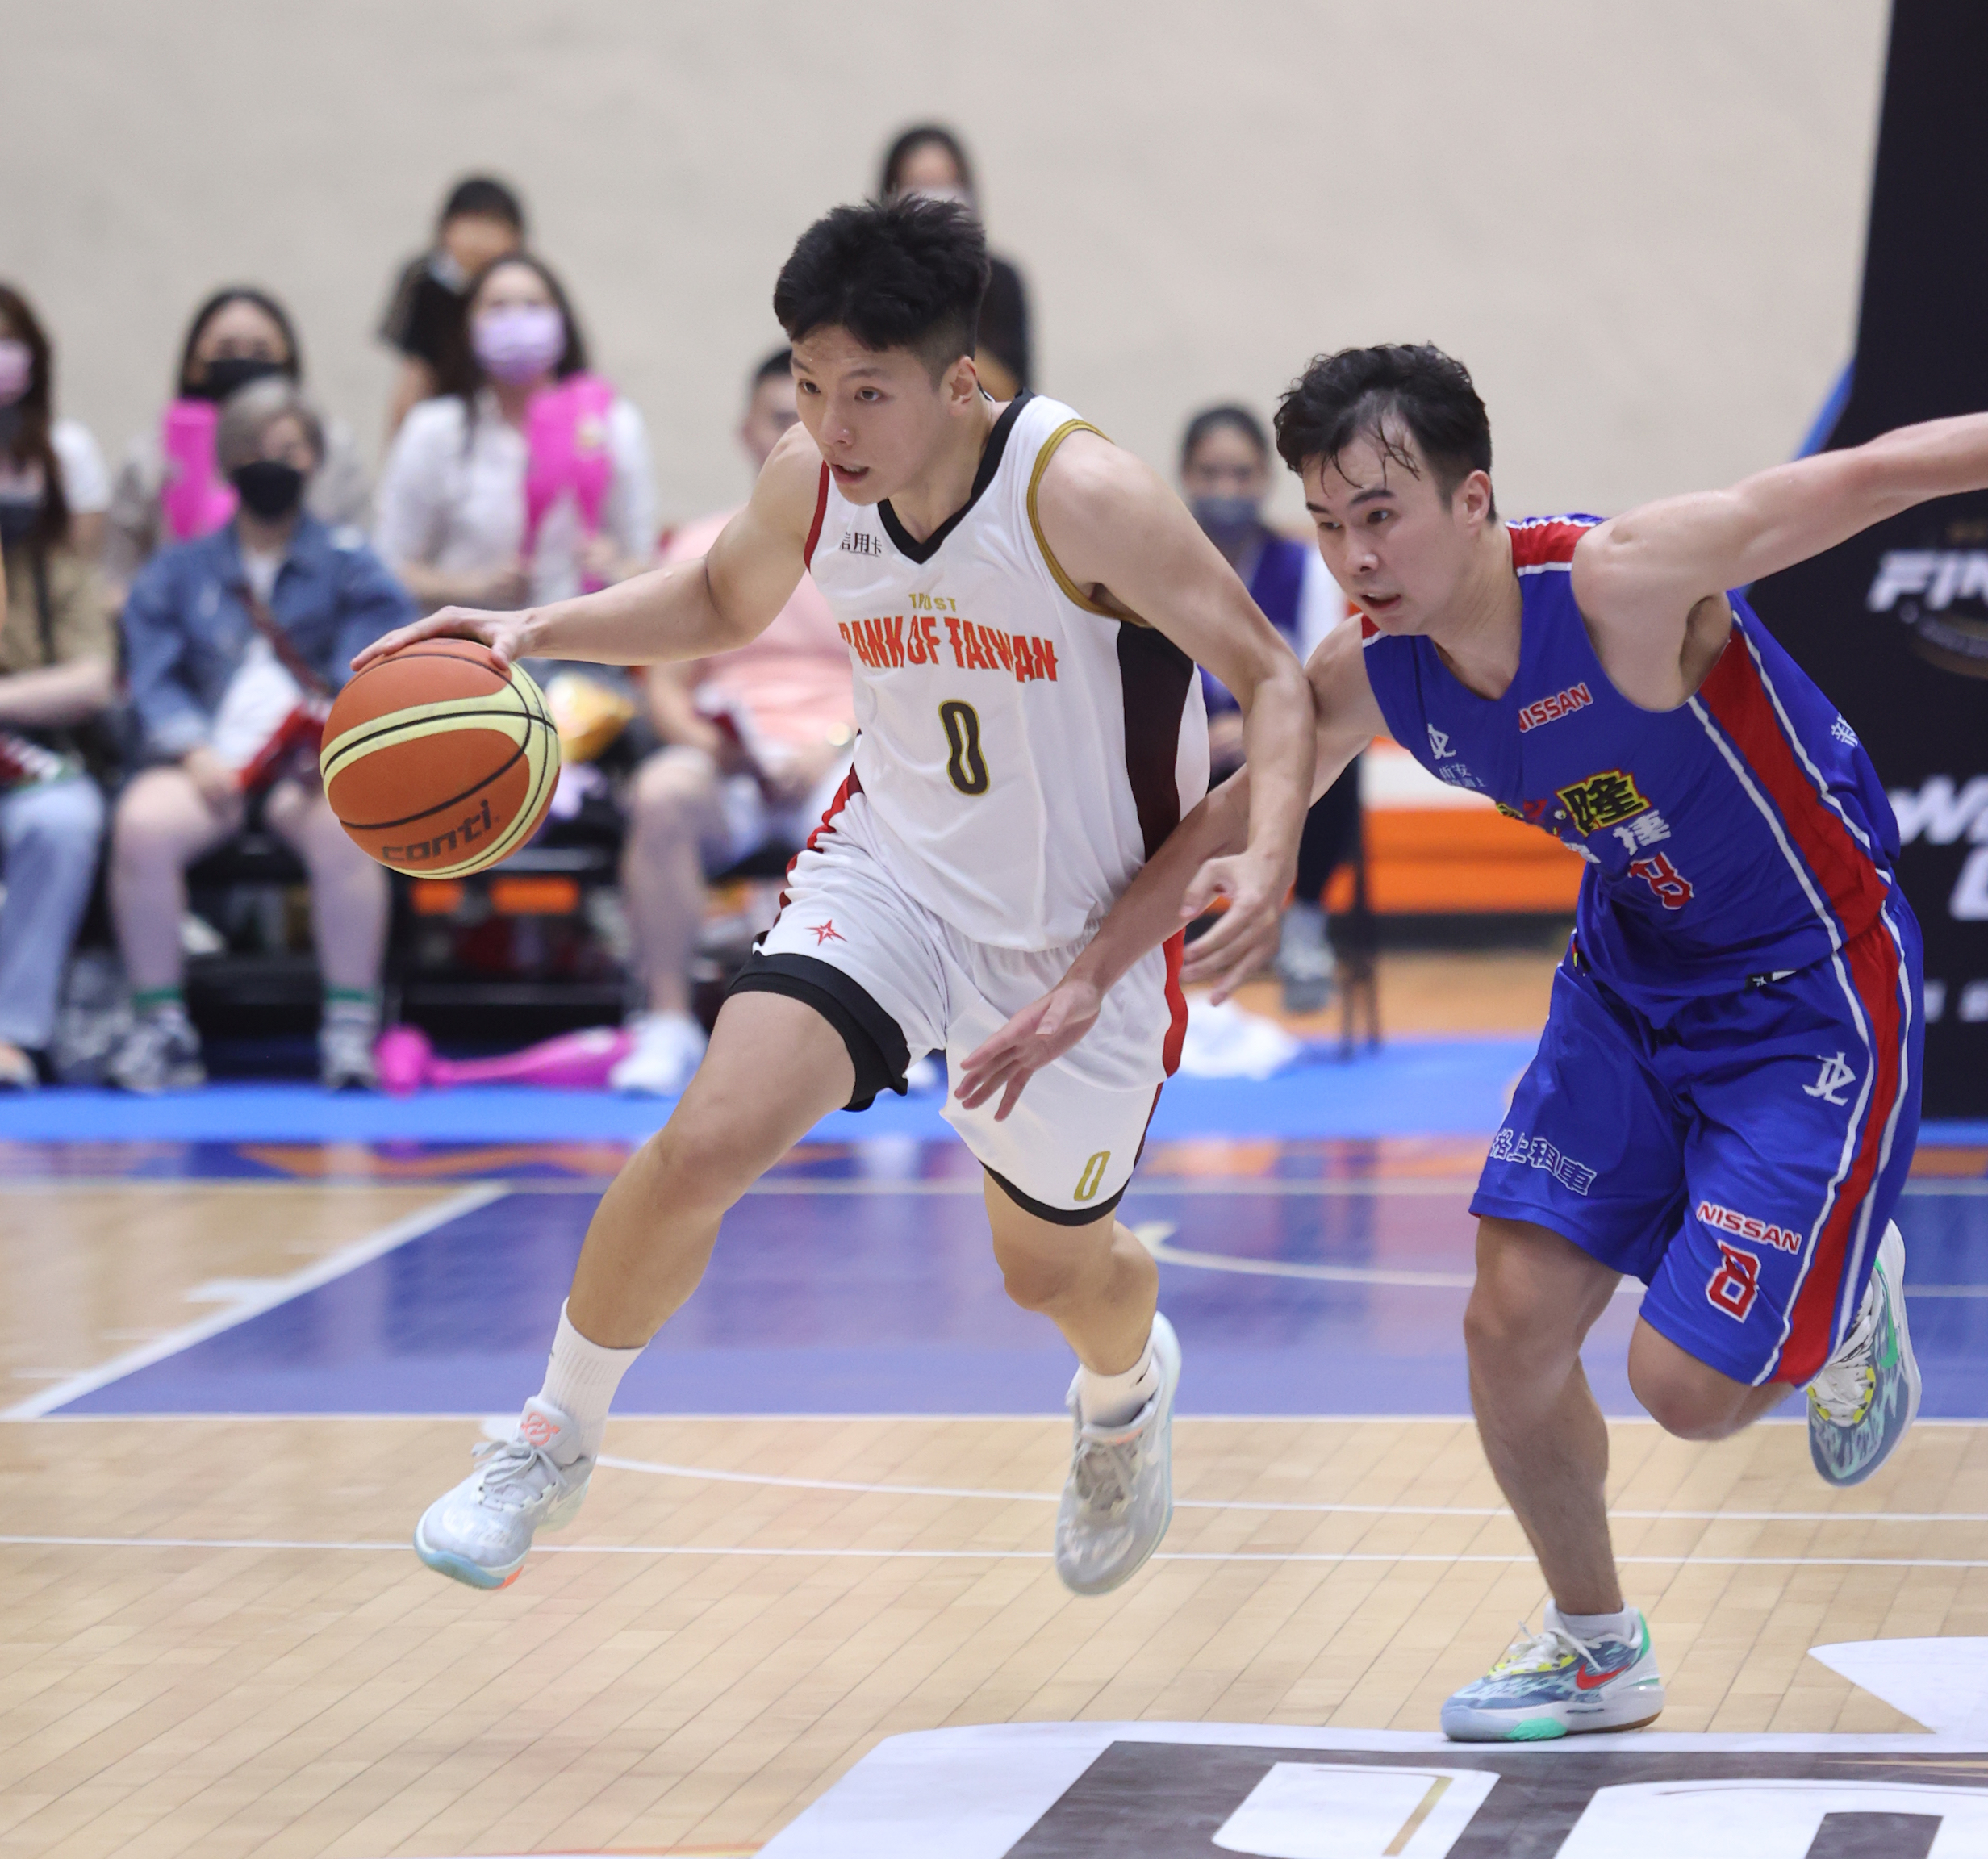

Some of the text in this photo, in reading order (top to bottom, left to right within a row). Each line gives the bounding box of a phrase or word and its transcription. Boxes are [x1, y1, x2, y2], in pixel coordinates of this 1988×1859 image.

[907, 614, 942, 666] OF
[943, 616, 1059, 683] TAIWAN
[938, 698, 991, 796] 0
[382, 799, 492, 863] conti
[1627, 850, 1694, 911] 8
[1073, 1151, 1111, 1202] 0
[1696, 1200, 1802, 1255] NISSAN
[1705, 1239, 1762, 1324] 8
